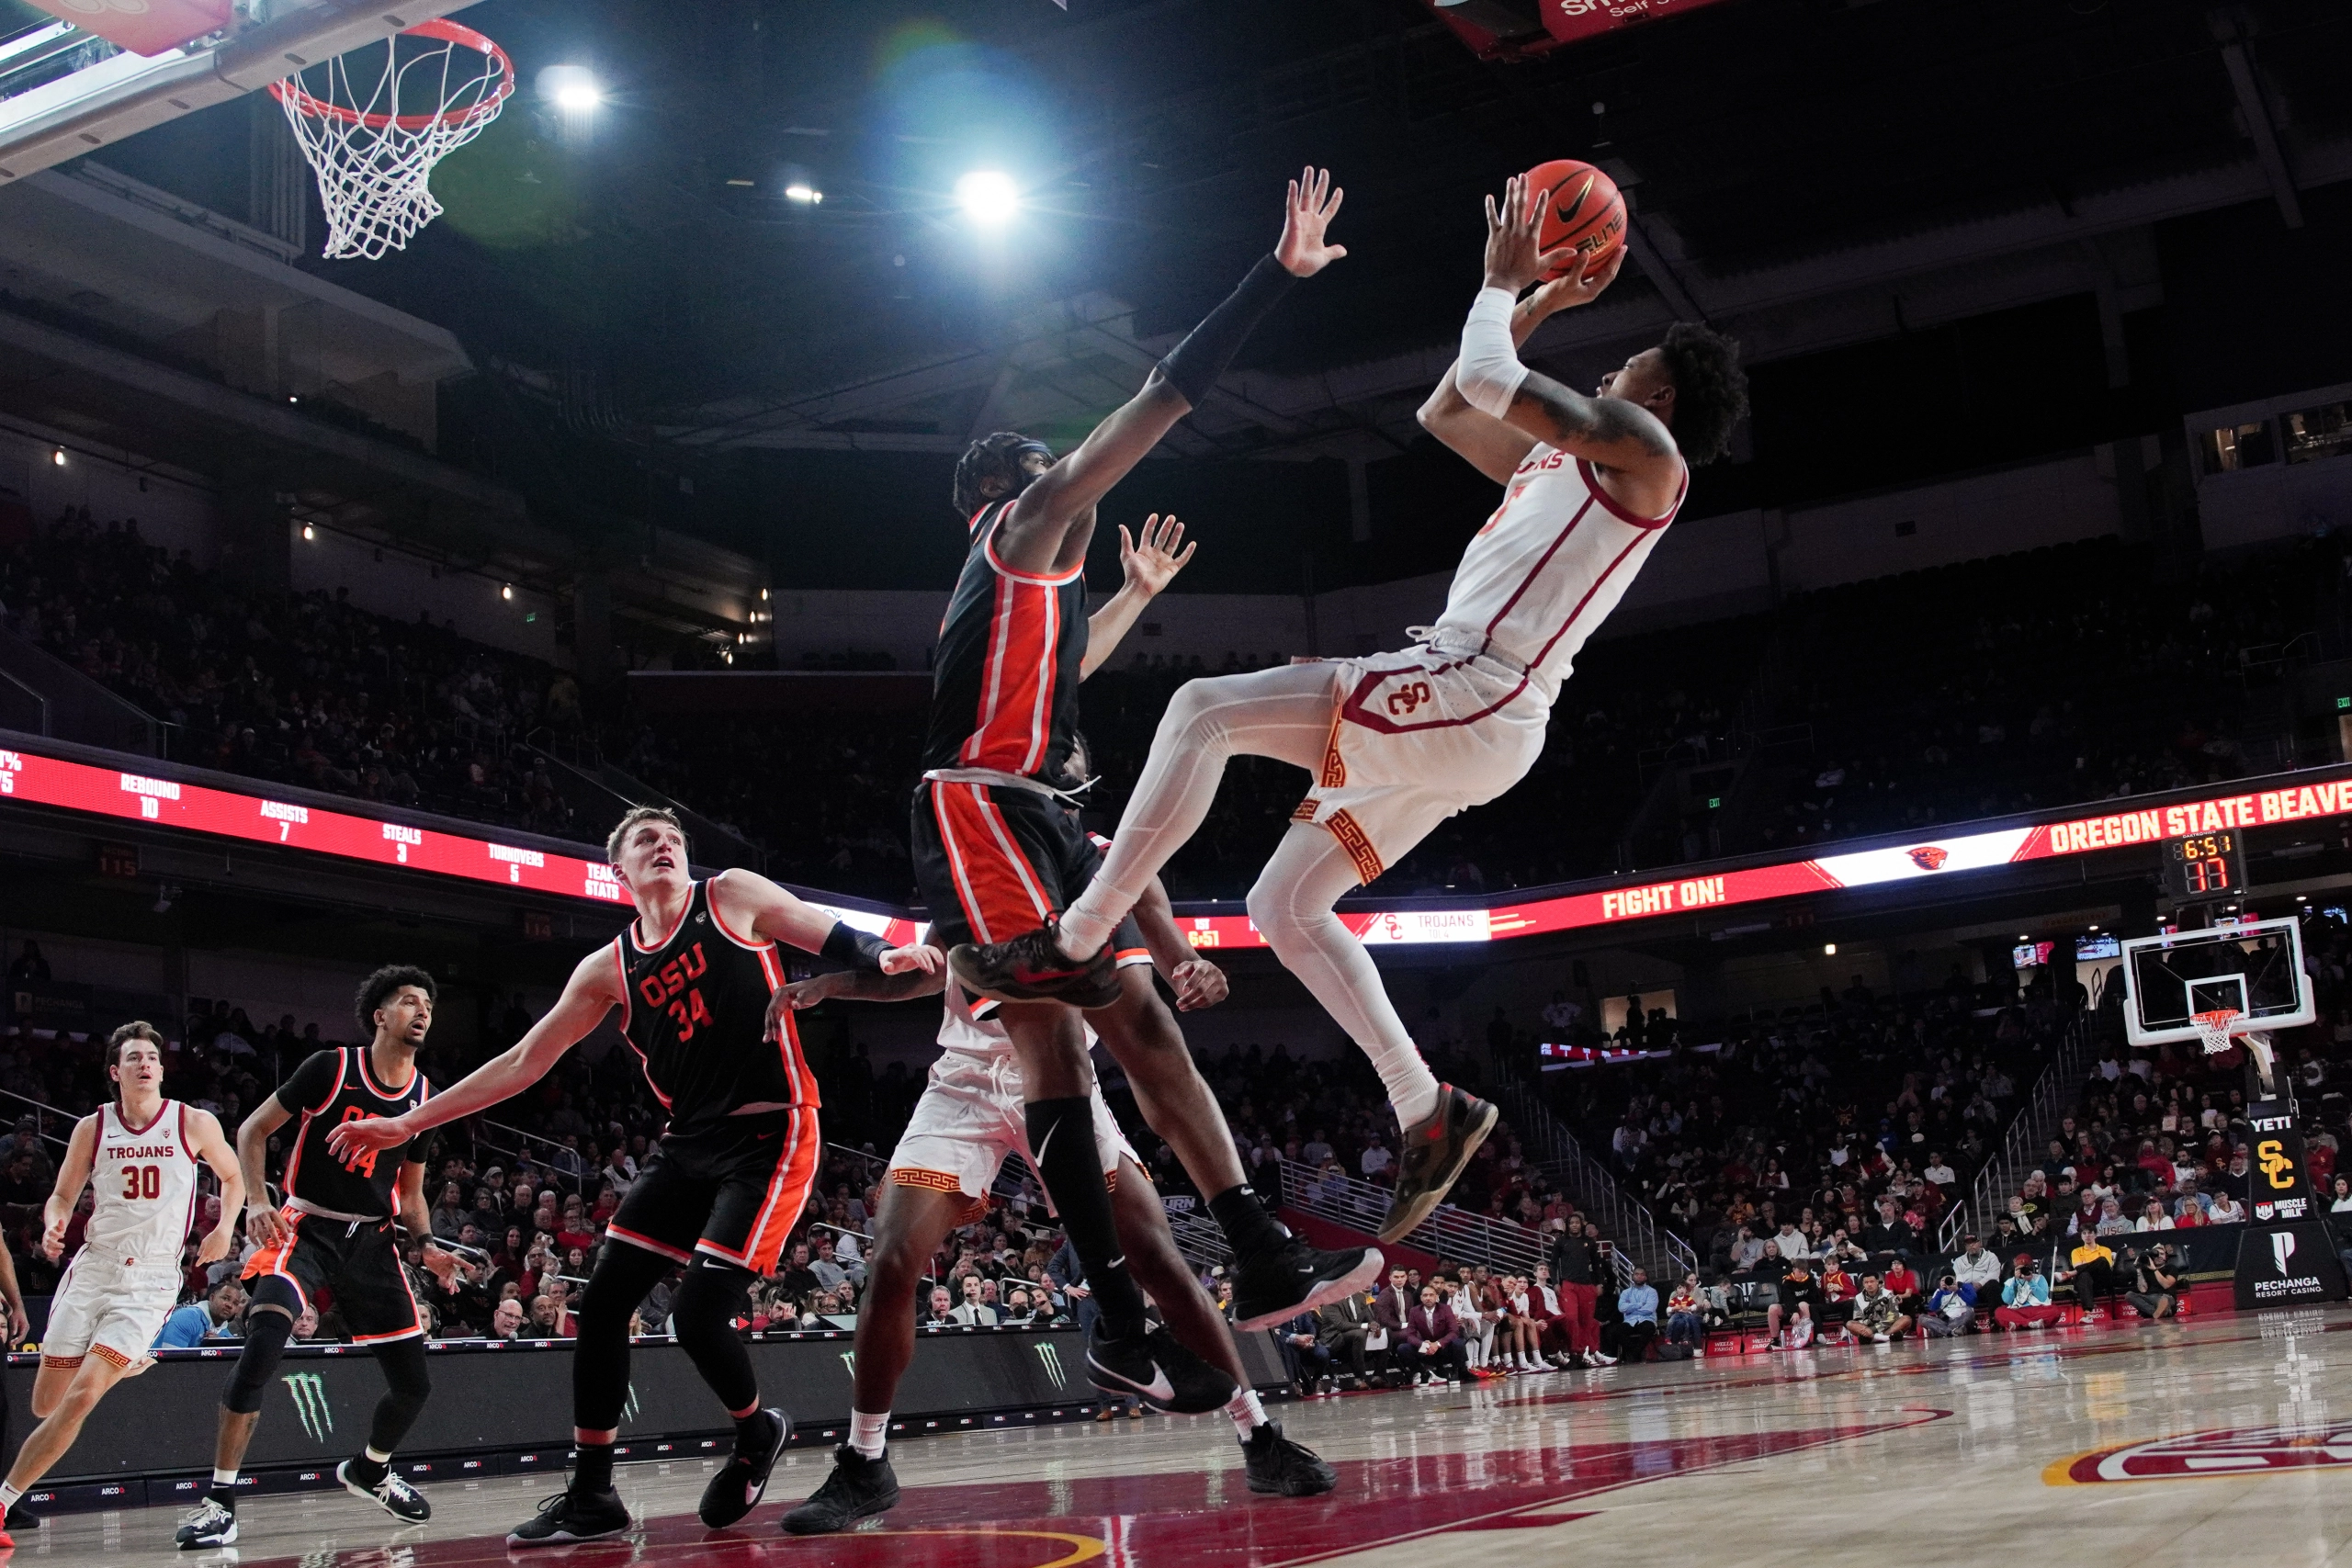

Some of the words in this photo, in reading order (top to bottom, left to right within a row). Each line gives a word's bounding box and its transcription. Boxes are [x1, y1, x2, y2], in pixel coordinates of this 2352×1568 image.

[1609, 0, 1649, 17] Self
[2337, 696, 2350, 708] EXIT
[120, 773, 180, 800] REBOUND
[140, 795, 159, 819] 10
[260, 800, 308, 824] ASSISTS
[2051, 810, 2161, 853] OREGON
[2167, 796, 2256, 836] STATE
[2260, 782, 2352, 823] BEAVE
[279, 821, 290, 841] 7
[382, 823, 422, 845] STEALS
[397, 843, 407, 863] 3
[488, 843, 545, 867] TURNOVERS
[2186, 835, 2231, 859] 6:51
[510, 864, 520, 883] 5
[2197, 857, 2228, 891] 17
[585, 879, 619, 900] STATS
[1602, 885, 1674, 919] FIGHT
[1680, 876, 1724, 907] ON!
[1194, 918, 1210, 930] 1ST
[1418, 914, 1474, 928] TROJANS
[639, 942, 707, 1008] OSU
[668, 987, 714, 1043] 34
[2250, 1115, 2292, 1133] YETI
[107, 1146, 174, 1159] TROJANS
[2257, 1140, 2295, 1189] SC
[121, 1165, 160, 1200] 30
[2274, 1198, 2307, 1211] MUSCLE
[2281, 1207, 2302, 1219] MILK
[2103, 1225, 2123, 1235] USC
[2255, 1277, 2320, 1292] PECHANGA
[2256, 1289, 2287, 1298] RESORT
[2290, 1286, 2322, 1295] CASINO
[175, 1482, 192, 1490] ARCO
[236, 1476, 253, 1485] ARCO
[300, 1472, 316, 1481] ARCO
[30, 1493, 50, 1502] ARCO
[101, 1486, 119, 1495] ARCO
